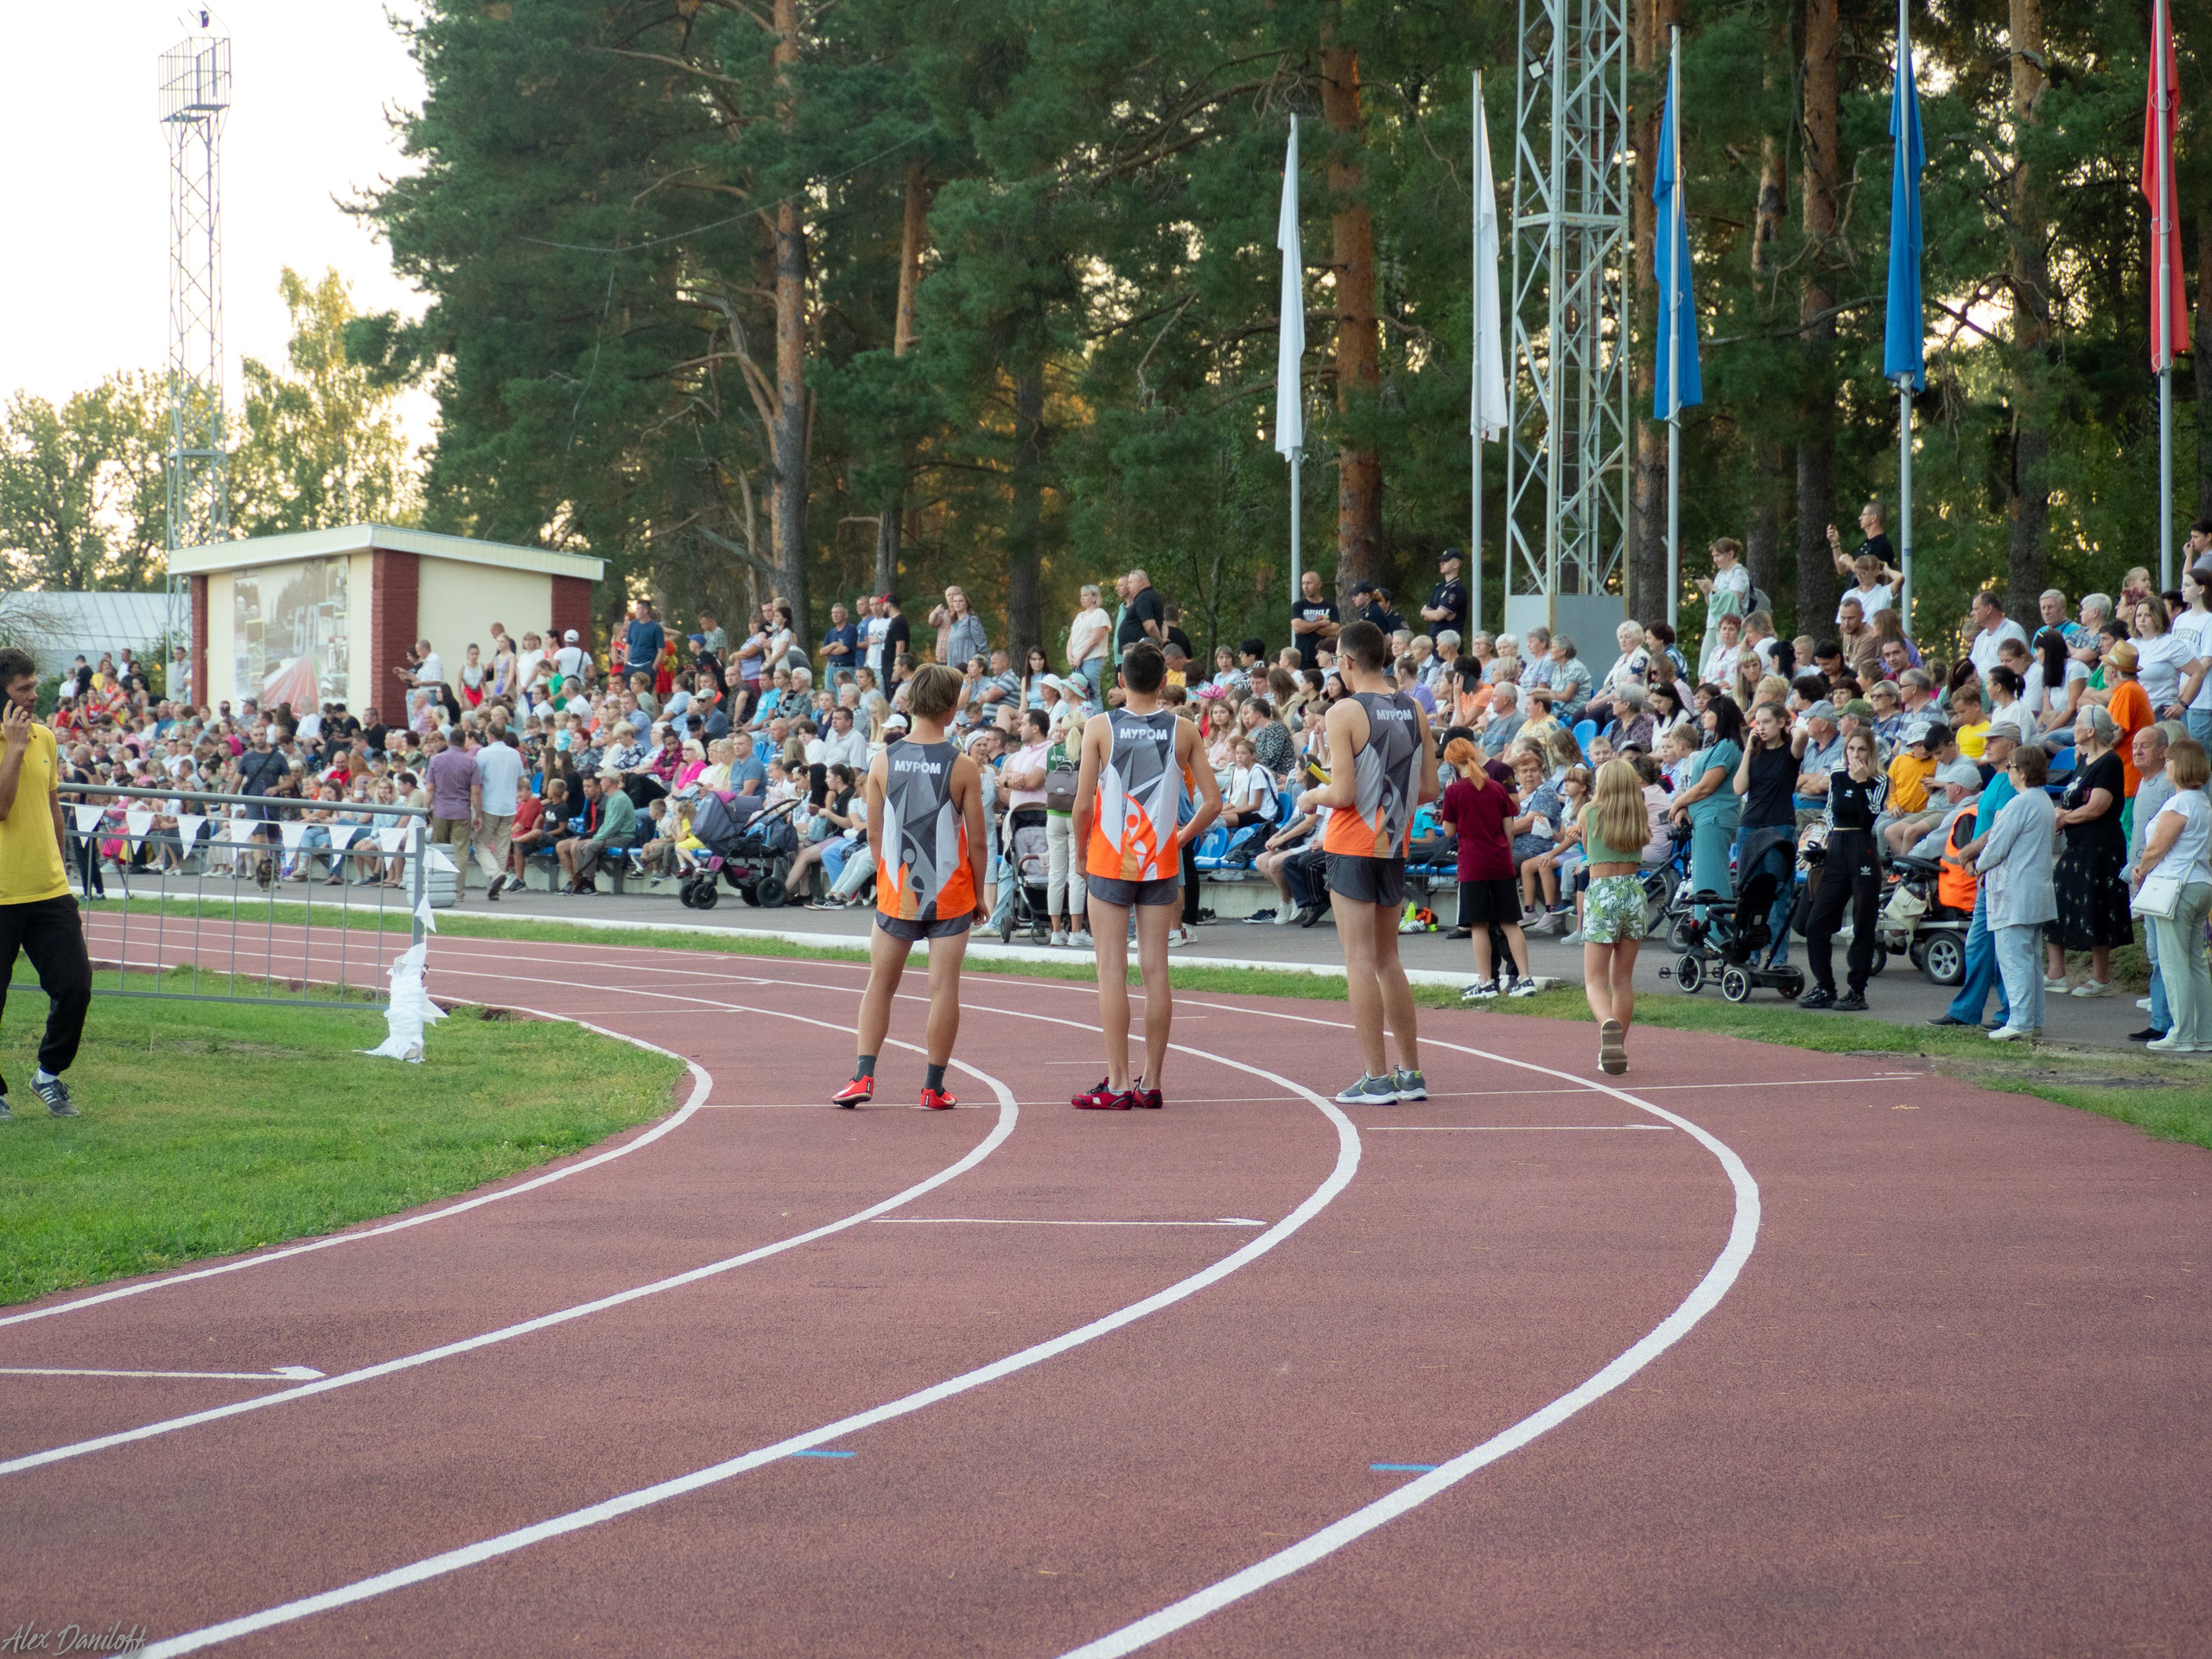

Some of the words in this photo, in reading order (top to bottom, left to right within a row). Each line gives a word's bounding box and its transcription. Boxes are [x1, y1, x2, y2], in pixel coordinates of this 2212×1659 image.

[1376, 709, 1413, 721] МУРОМ
[1119, 728, 1168, 741] МУРОМ
[893, 760, 941, 774] МУРОМ
